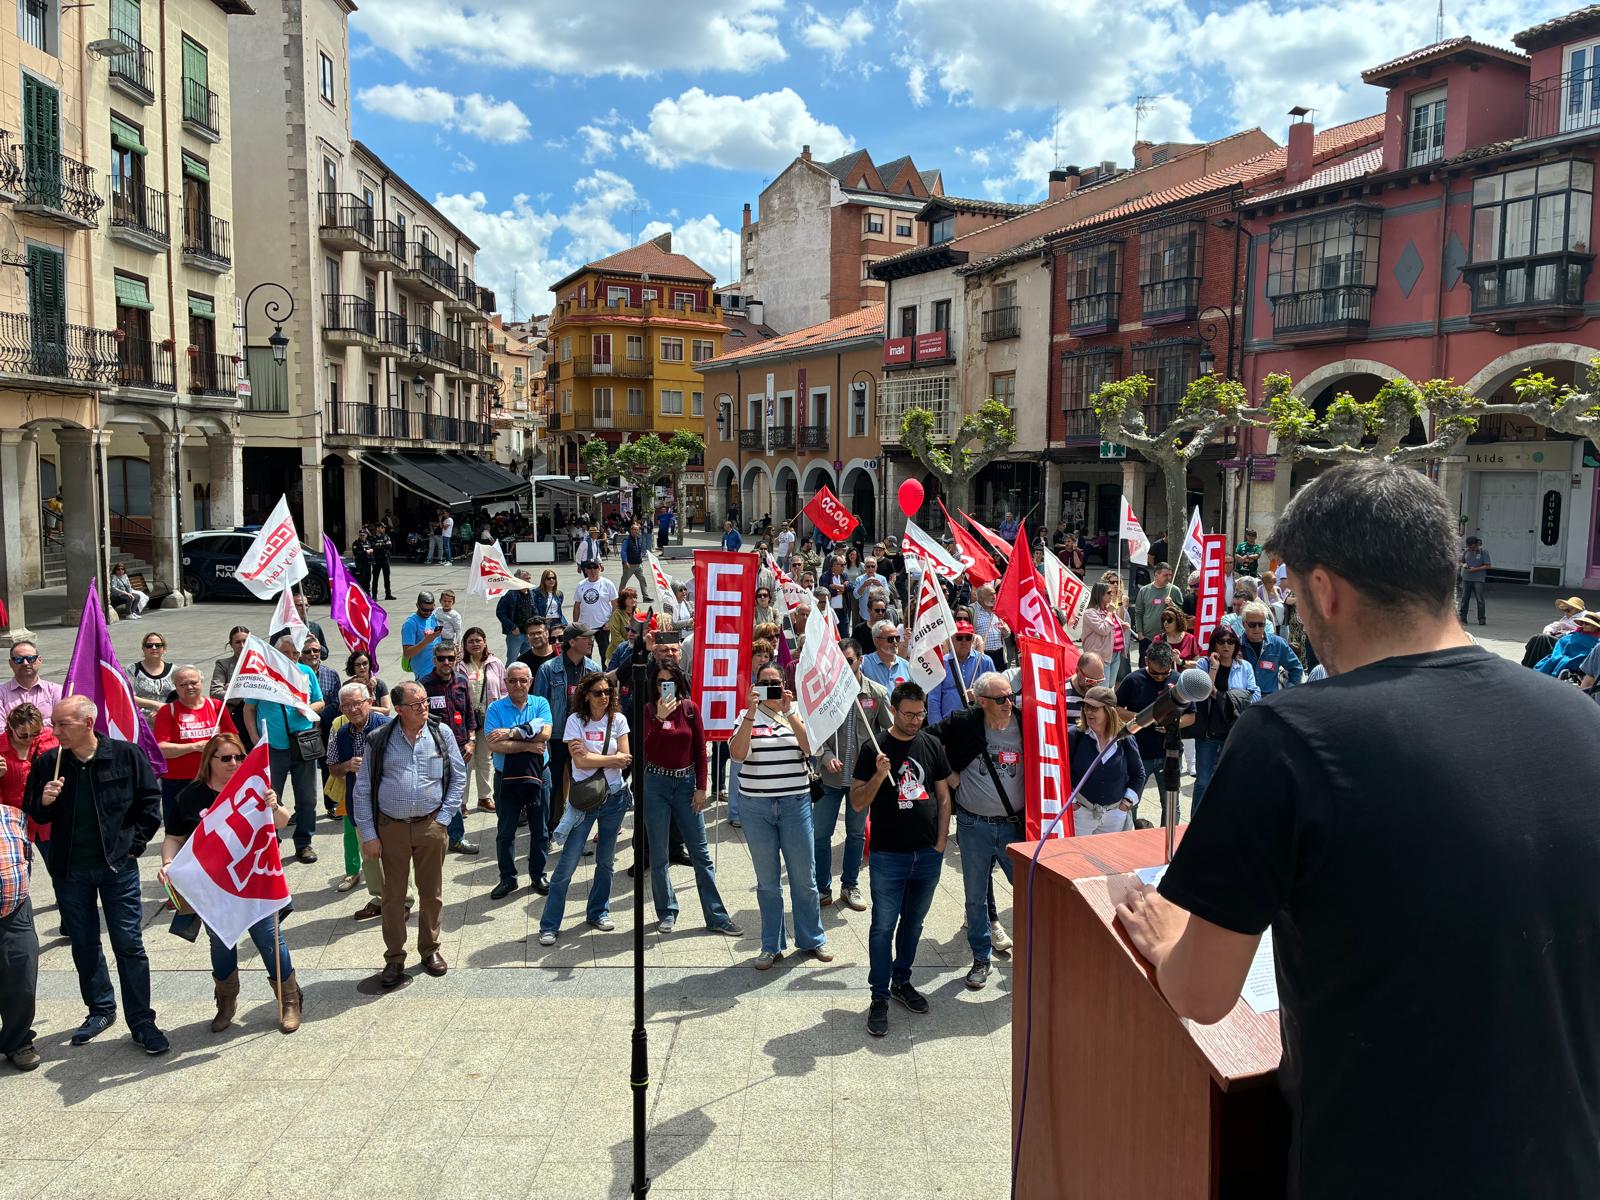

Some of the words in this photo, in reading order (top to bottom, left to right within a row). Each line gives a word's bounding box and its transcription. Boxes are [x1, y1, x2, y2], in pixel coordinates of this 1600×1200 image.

[1475, 454, 1505, 463] kids
[821, 496, 850, 530] CC.OO.
[701, 562, 743, 730] CCOO
[243, 682, 272, 691] Castilla
